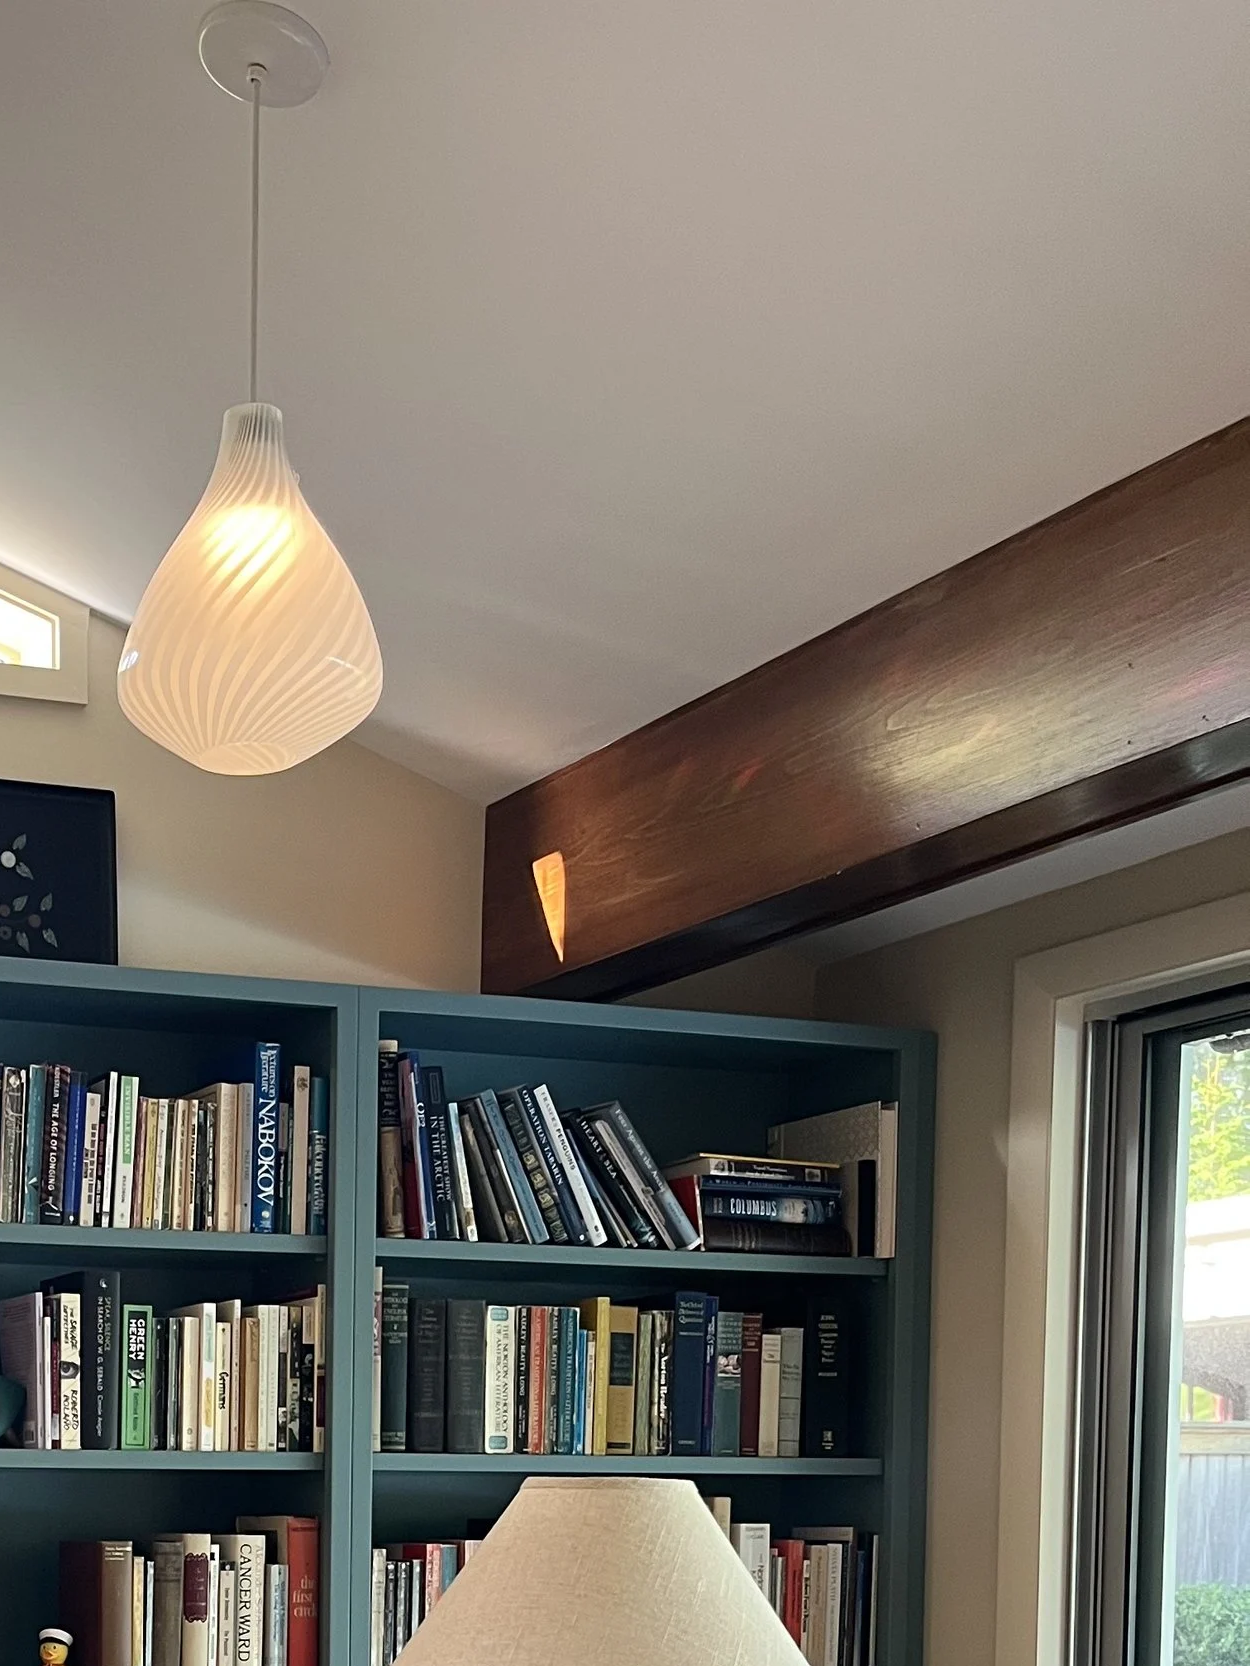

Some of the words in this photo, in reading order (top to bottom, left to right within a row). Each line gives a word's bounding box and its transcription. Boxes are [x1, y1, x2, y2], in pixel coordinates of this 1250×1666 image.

[49, 1119, 59, 1138] AGE
[50, 1102, 59, 1119] THE
[429, 1115, 438, 1129] IN
[437, 1115, 446, 1134] THE
[49, 1140, 58, 1151] OF
[123, 1133, 131, 1155] MAN
[256, 1097, 276, 1206] NABOKOV
[430, 1131, 440, 1156] THE
[438, 1132, 449, 1174] GREATEST
[520, 1088, 548, 1145] OPERATION
[542, 1145, 564, 1186] TABARIN
[553, 1127, 577, 1171] PENGUINS
[579, 1118, 604, 1155] HEART
[47, 1151, 57, 1191] LONGING
[432, 1157, 445, 1202] ARCTIC
[601, 1157, 618, 1180] SEA
[641, 1154, 654, 1170] the
[443, 1176, 452, 1201] SHOW
[730, 1197, 777, 1217] COLUMBUS
[68, 1319, 77, 1351] SAVAGE
[103, 1322, 111, 1351] SILENCE
[128, 1318, 137, 1361] HENRY
[136, 1318, 145, 1360] GREEN
[494, 1336, 502, 1381] AMERICAN
[501, 1342, 509, 1378] NORTON
[217, 1371, 229, 1410] Germans
[549, 1375, 557, 1395] LONG
[62, 1393, 71, 1431] BOLAÑO
[69, 1388, 78, 1430] ROBERTO
[501, 1381, 509, 1433] ANTHOLOGY
[238, 1543, 252, 1611] CANCER
[237, 1613, 251, 1662] WARD
